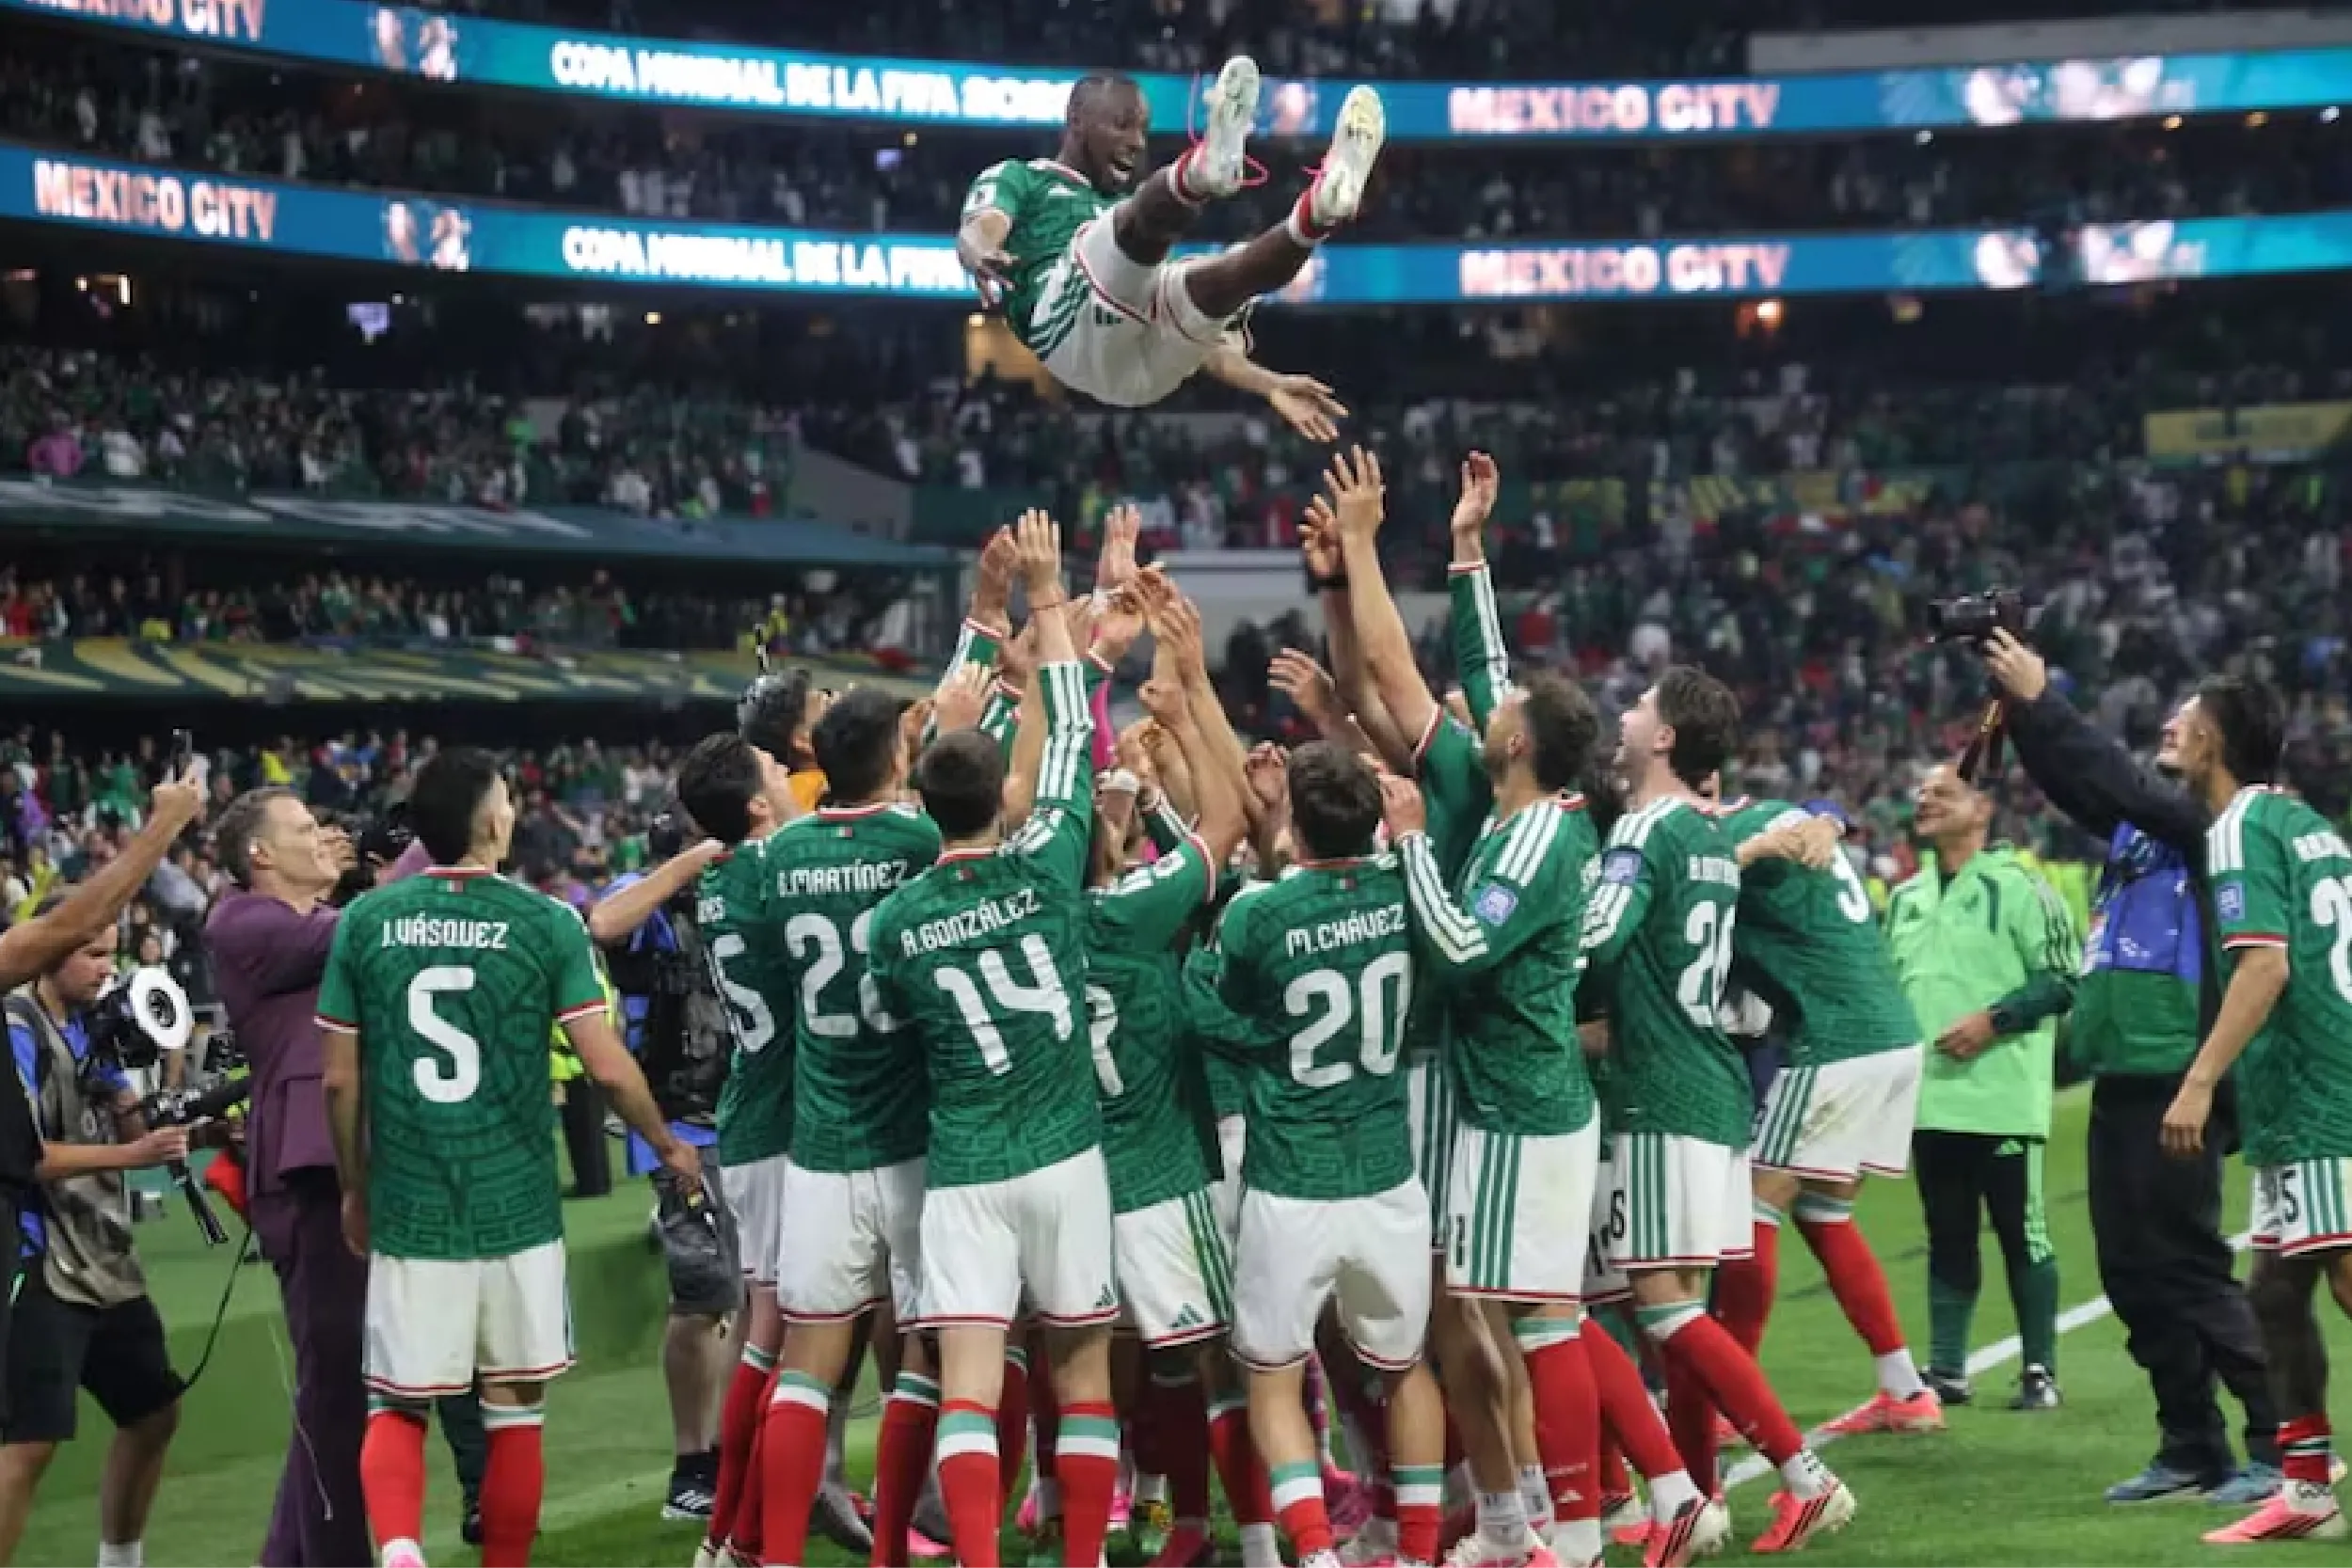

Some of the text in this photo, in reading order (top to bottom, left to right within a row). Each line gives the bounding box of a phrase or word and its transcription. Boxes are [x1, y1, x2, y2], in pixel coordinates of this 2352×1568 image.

[1450, 83, 1780, 135] MEXICO CITY
[34, 159, 277, 242] MEXICO CITY
[1459, 244, 1789, 298] MEXICO CITY
[381, 910, 510, 950] J.VÁSQUEZ
[900, 888, 1042, 959] A.GONZÁLEZ
[1285, 902, 1408, 959] M.CHÁVEZ
[407, 965, 481, 1103] 5
[933, 932, 1073, 1077] 14
[1282, 950, 1412, 1088] 20
